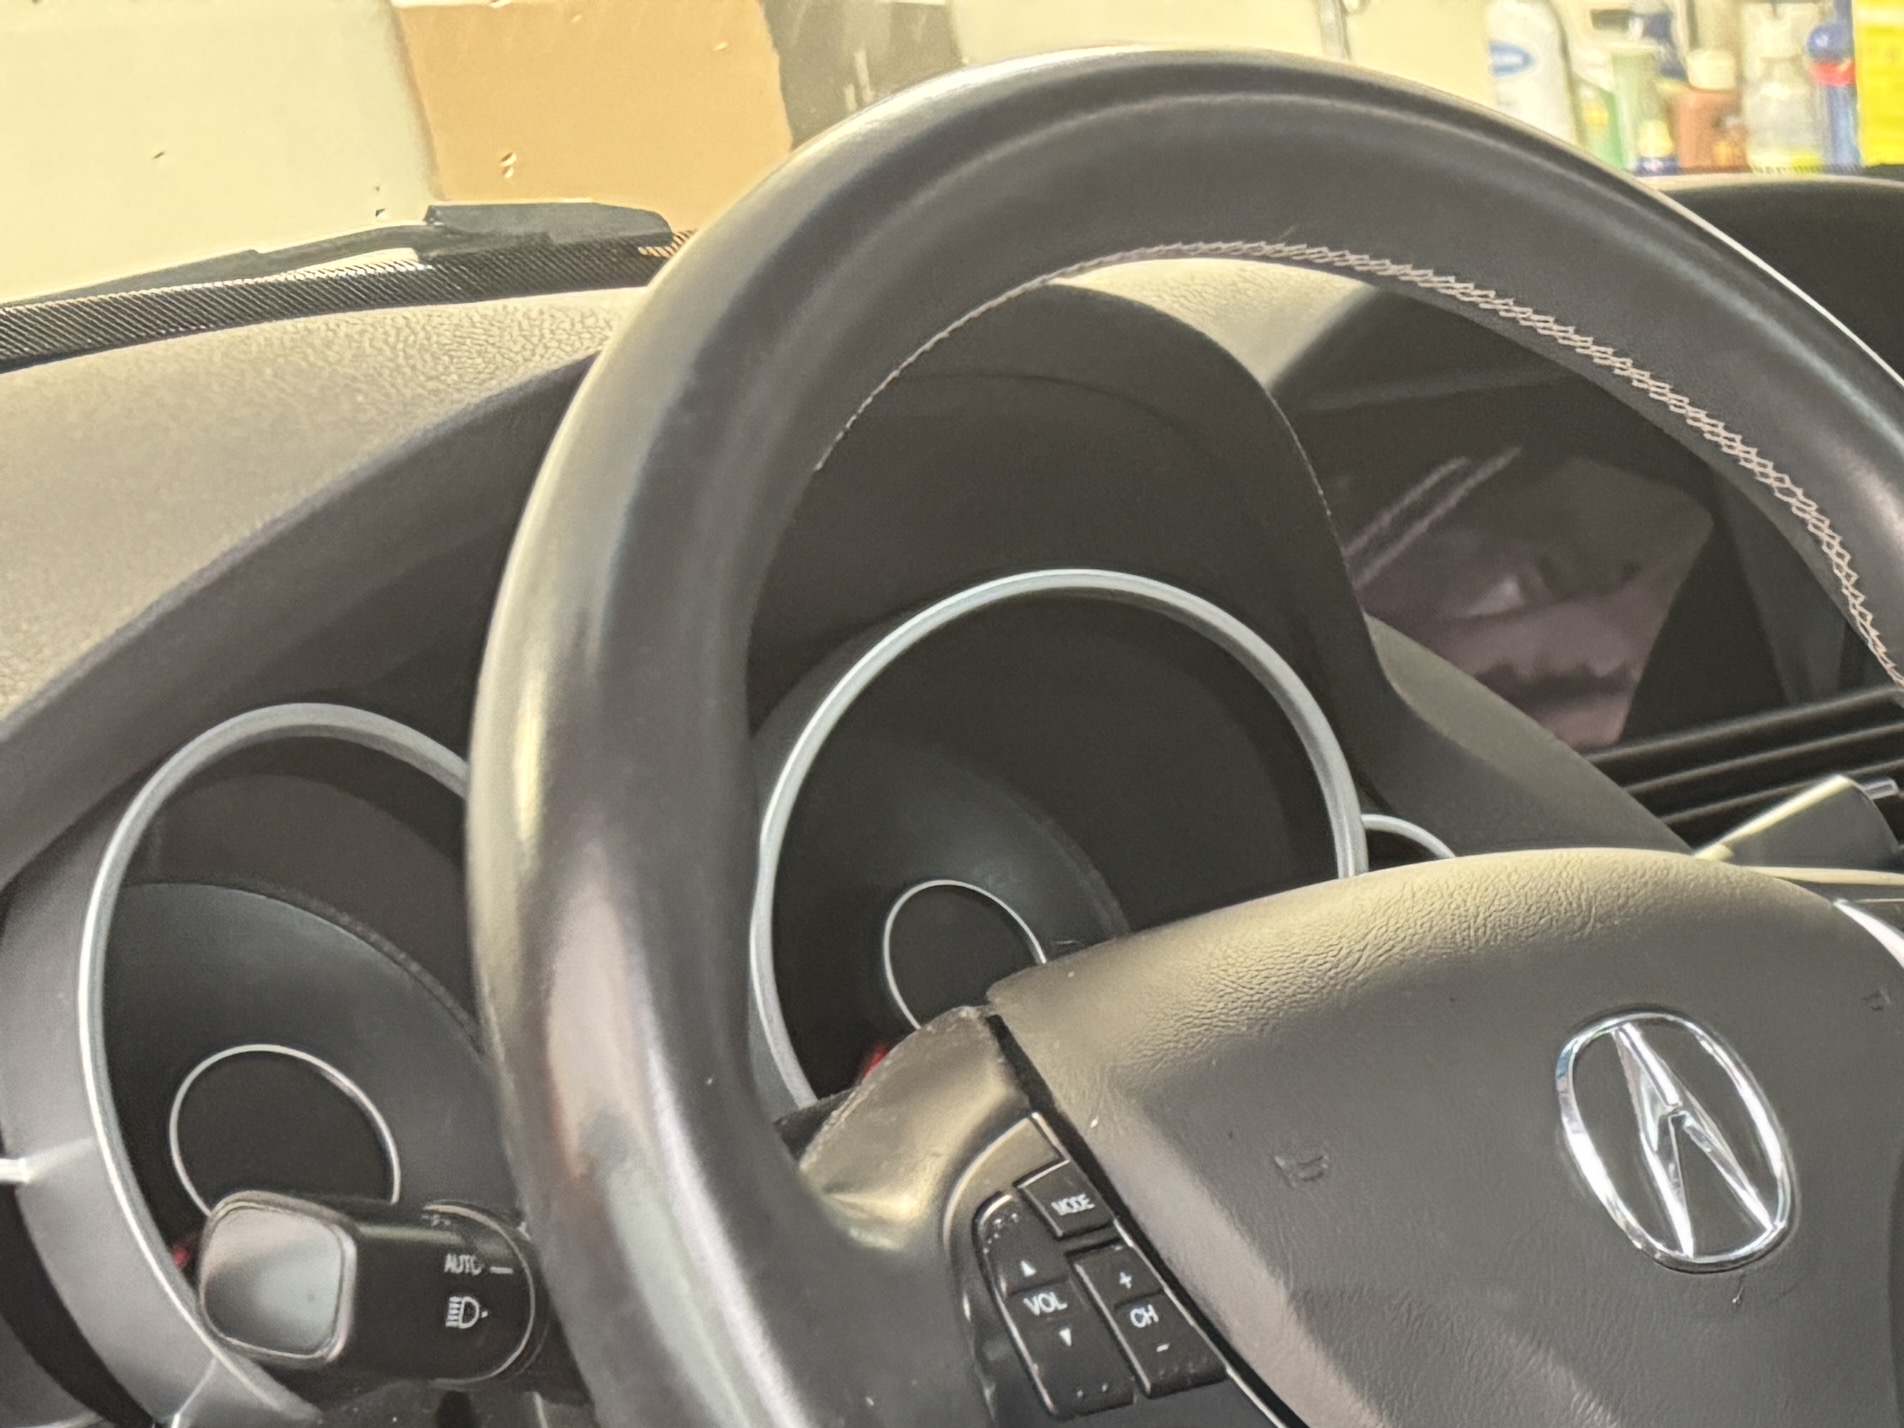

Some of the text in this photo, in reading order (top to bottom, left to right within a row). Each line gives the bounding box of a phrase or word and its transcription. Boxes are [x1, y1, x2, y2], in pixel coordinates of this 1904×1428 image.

[1051, 1193, 1096, 1216] MODE
[1023, 1291, 1068, 1315] VOL
[1130, 1304, 1159, 1328] CH
